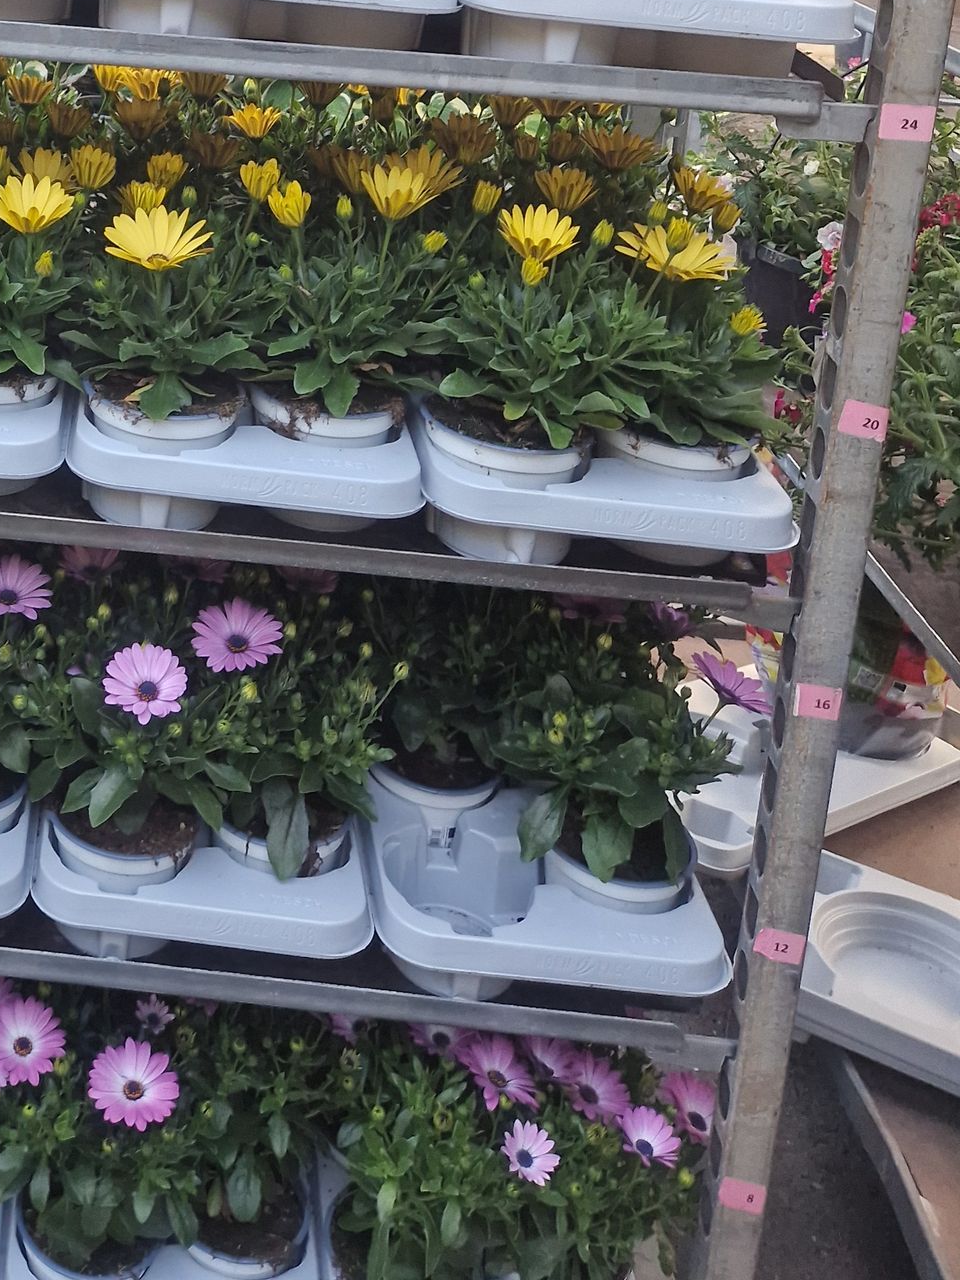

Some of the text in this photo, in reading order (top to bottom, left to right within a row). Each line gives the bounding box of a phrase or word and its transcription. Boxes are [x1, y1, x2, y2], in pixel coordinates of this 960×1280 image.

[641, 0, 808, 32] NORM PACK 408
[900, 118, 917, 130] 24
[862, 417, 881, 431] 20
[332, 482, 369, 506] 408
[593, 507, 632, 524] NORM
[711, 517, 746, 541] 408
[815, 698, 832, 710] 16
[774, 942, 791, 954] 12
[746, 1193, 754, 1203] 8
